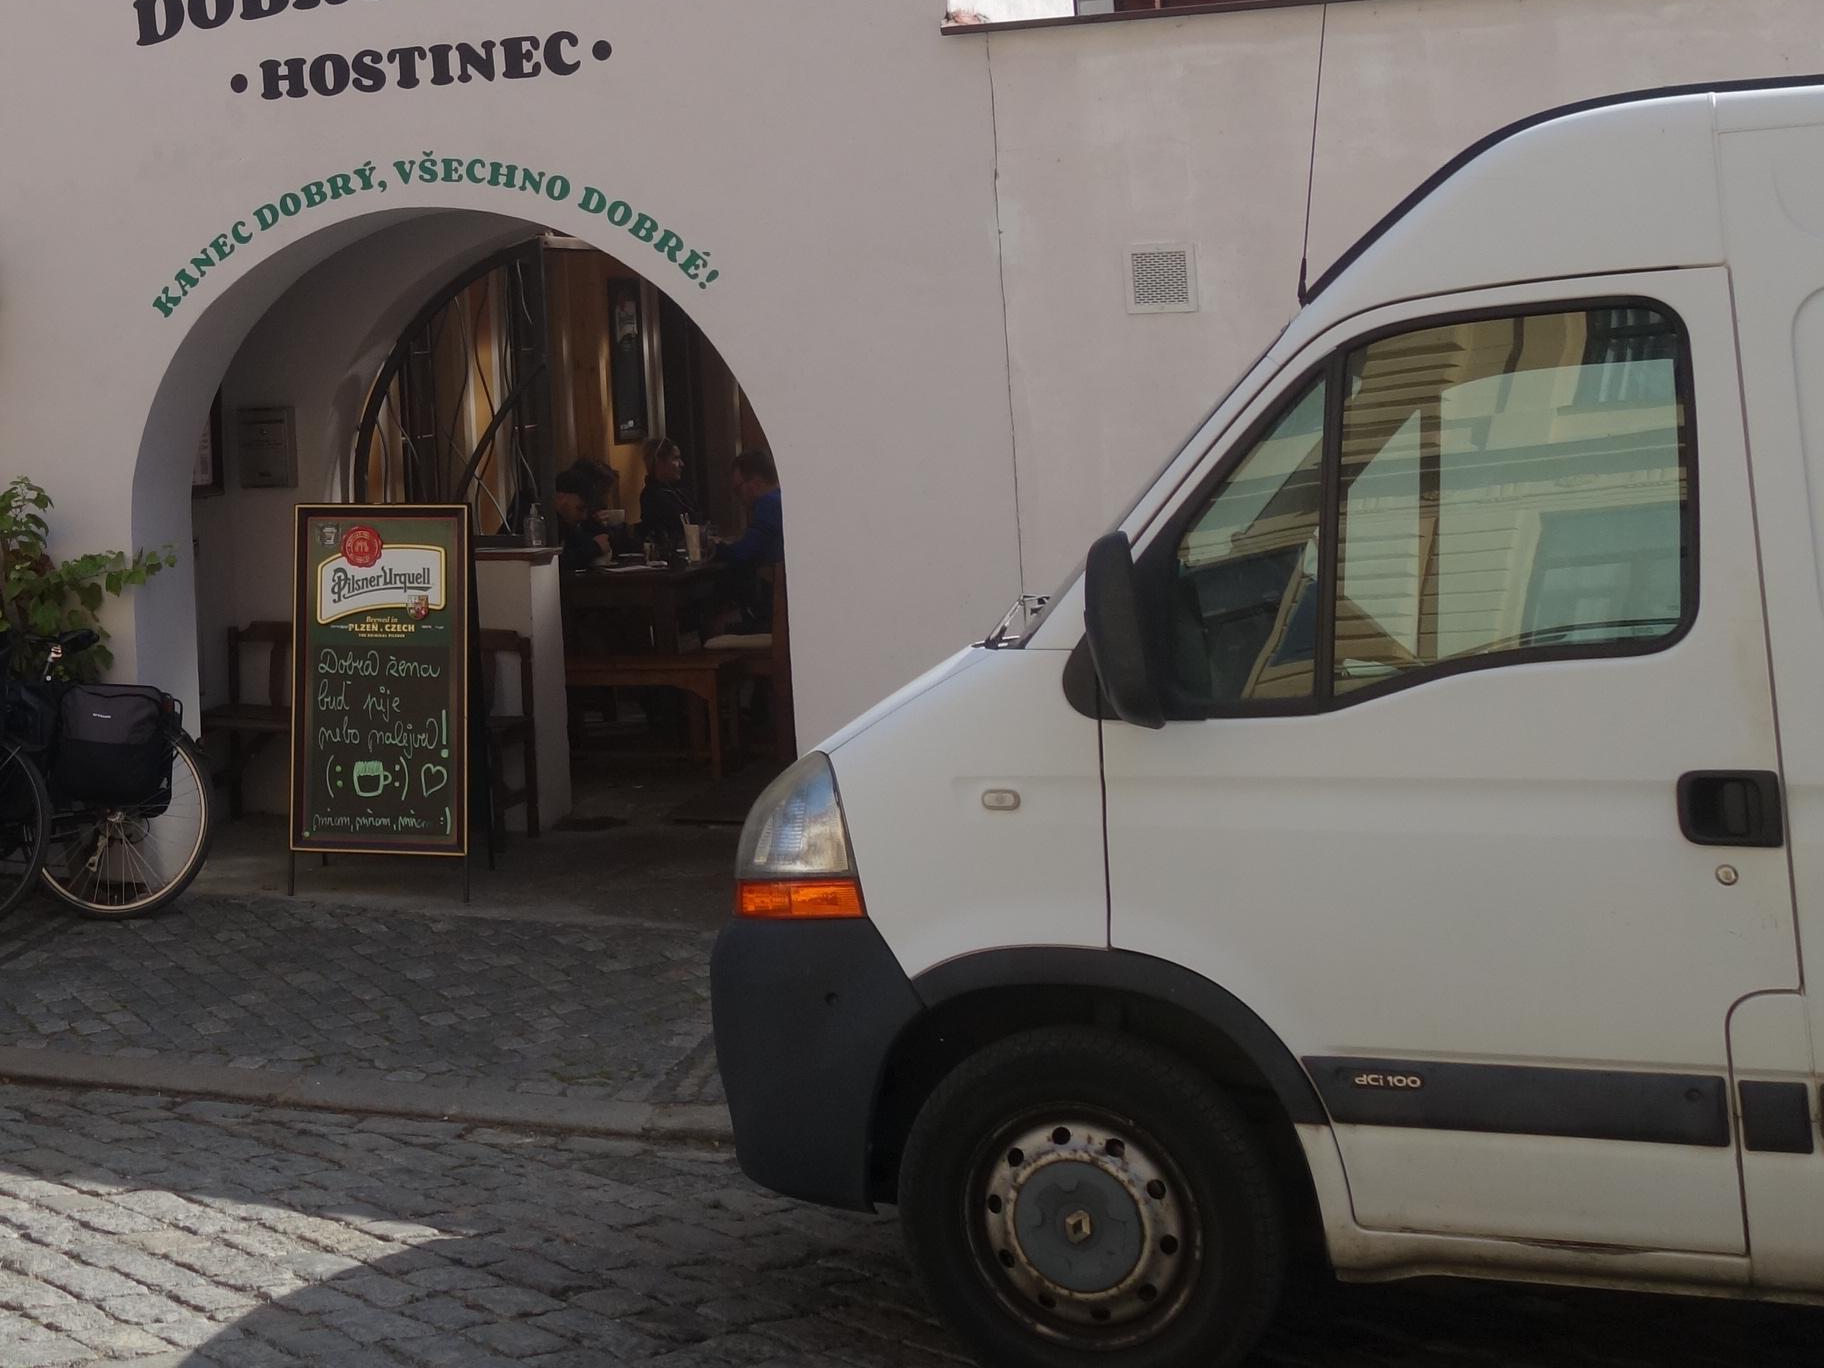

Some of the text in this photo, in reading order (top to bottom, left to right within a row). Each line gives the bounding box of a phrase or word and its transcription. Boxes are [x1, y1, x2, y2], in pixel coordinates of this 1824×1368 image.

[259, 31, 581, 100] HOSTINEC
[153, 150, 720, 318] KANEC DOBRÝ, VŠECHNO DOBRÉ!
[331, 566, 430, 604] Pilsner Urquell
[385, 624, 415, 632] CZECH
[363, 686, 401, 722] pije
[318, 715, 360, 750] nebo
[1354, 1074, 1421, 1088] dCi 100
